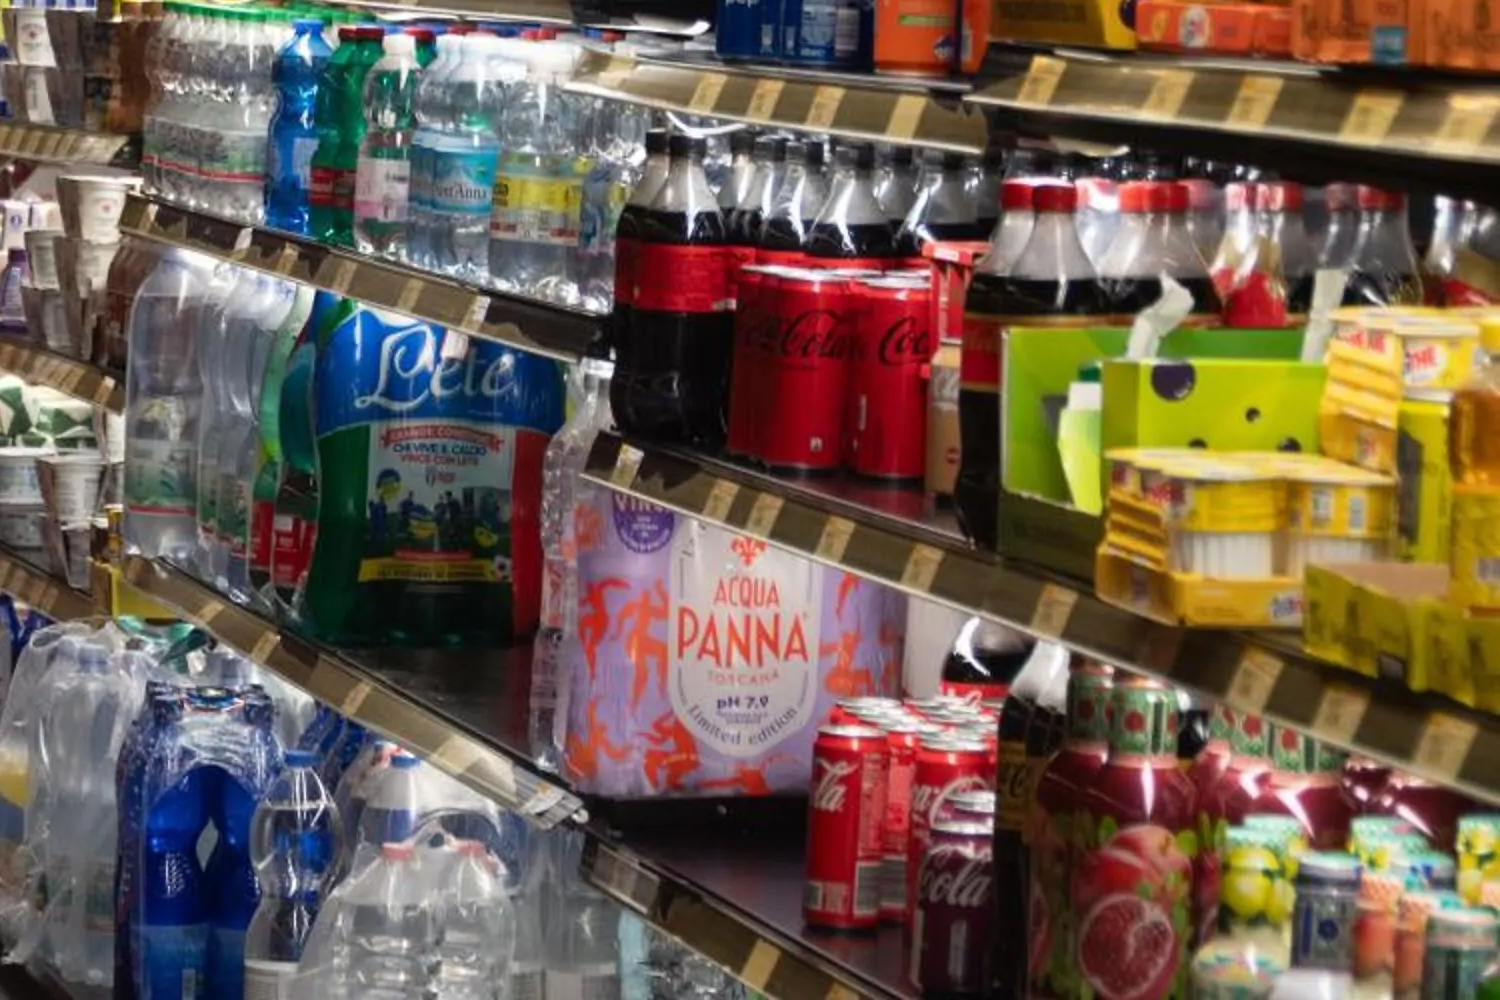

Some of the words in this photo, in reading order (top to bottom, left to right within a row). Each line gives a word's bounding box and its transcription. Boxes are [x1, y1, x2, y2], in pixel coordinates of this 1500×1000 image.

[354, 324, 518, 411] Lete
[713, 576, 780, 610] ACQUA
[677, 605, 809, 669] PANNA
[707, 669, 780, 686] TOSCANA
[717, 696, 740, 710] pH
[748, 707, 798, 746] edition
